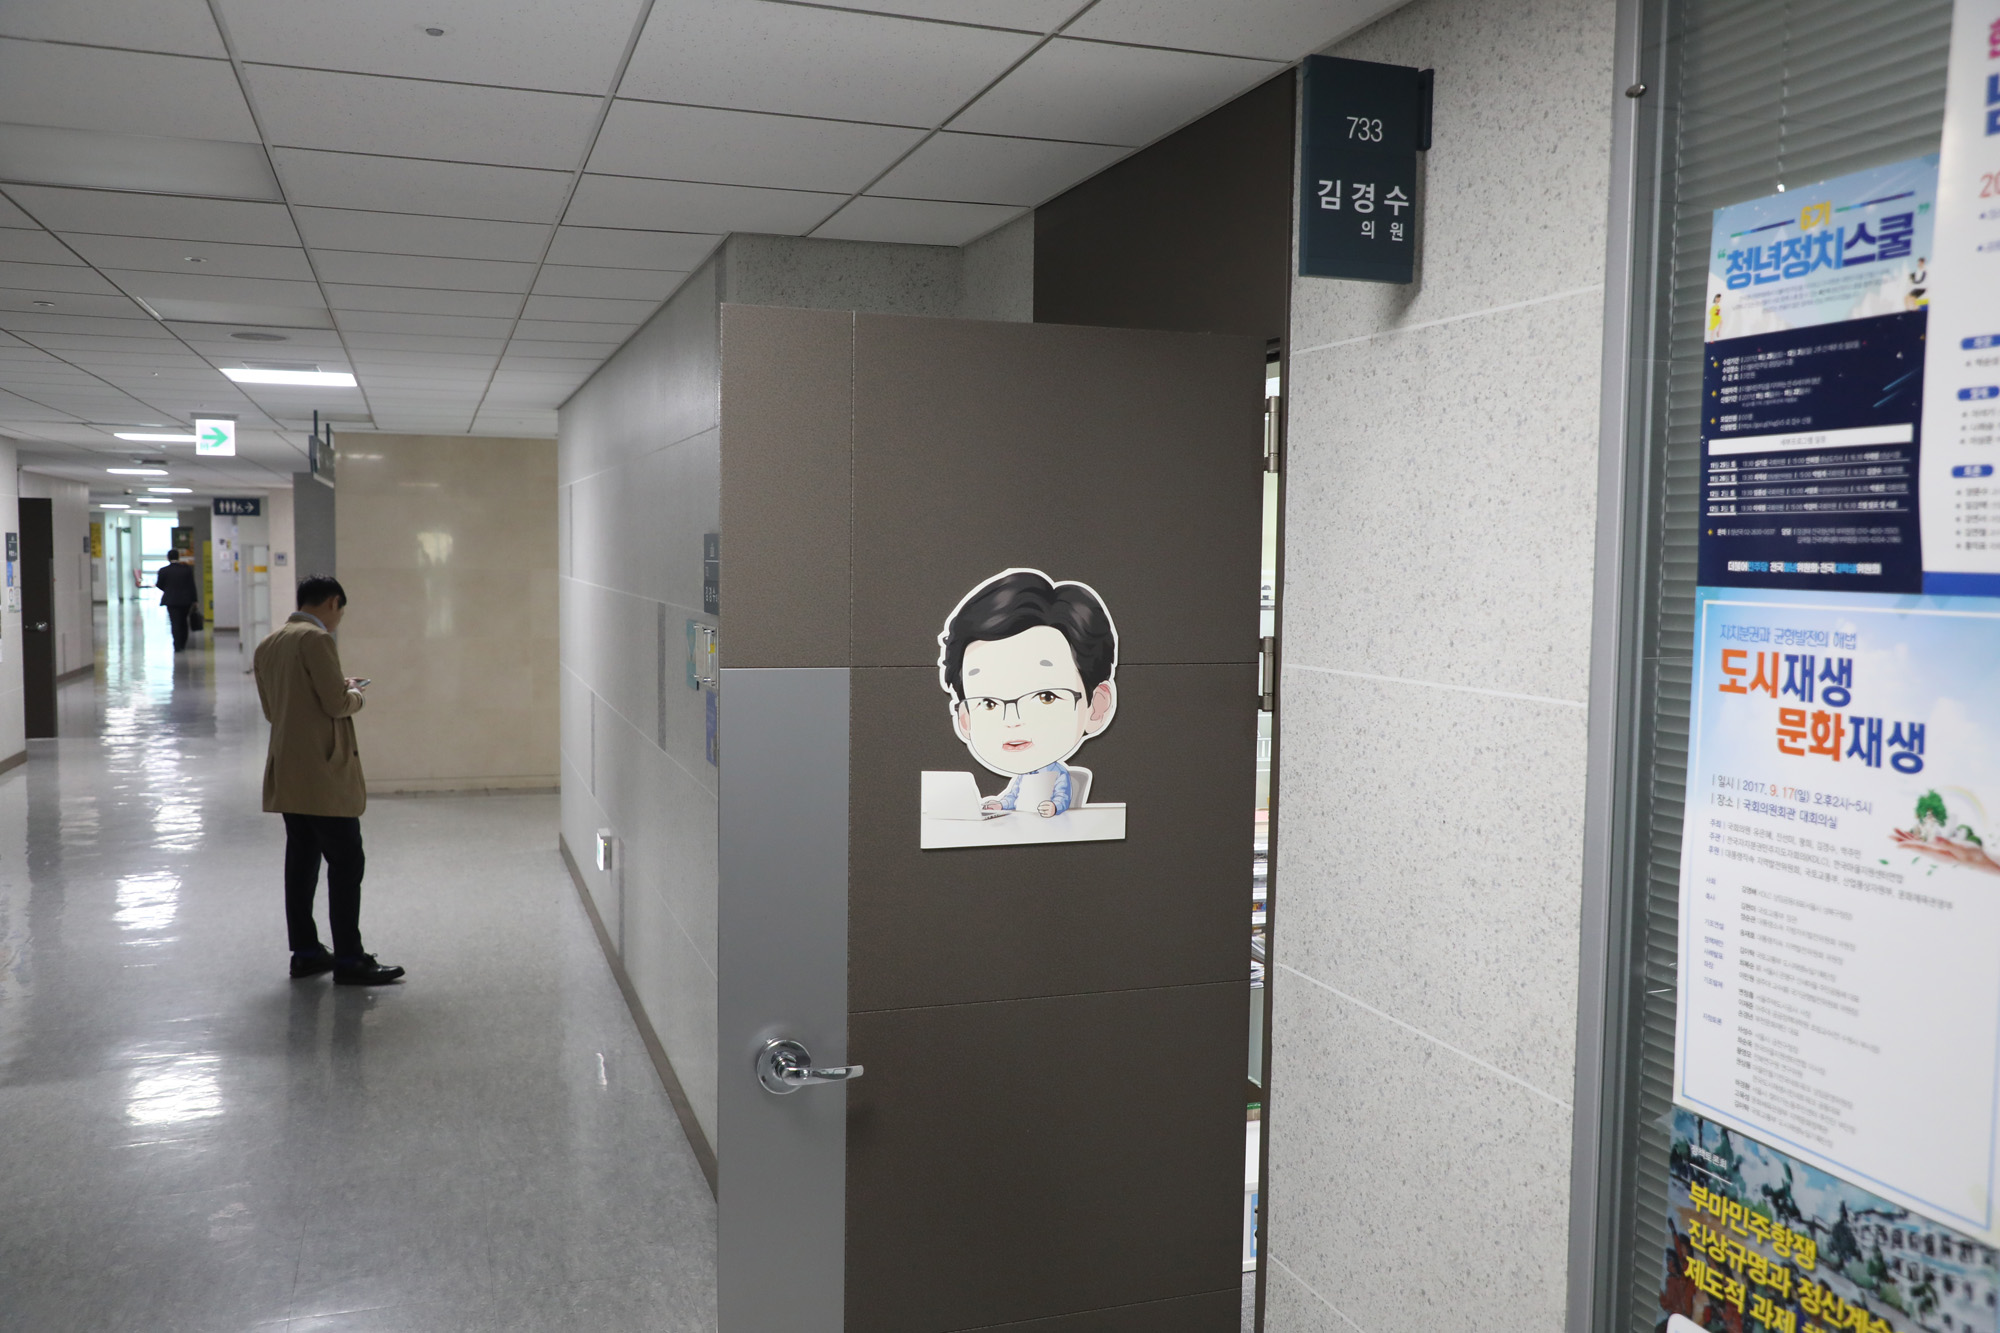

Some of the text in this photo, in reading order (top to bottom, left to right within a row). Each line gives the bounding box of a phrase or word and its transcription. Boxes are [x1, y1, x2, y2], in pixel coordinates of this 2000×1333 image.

[1346, 116, 1383, 142] 733
[1800, 201, 1831, 231] 6기
[1720, 623, 1857, 651] 자치분권과 균형발전의 해법
[1718, 648, 1853, 708] 도시재생
[1776, 707, 1925, 774] 문화재생
[1717, 775, 1735, 789] 일시
[1716, 792, 1838, 830] 장소 국회의원회관 대회의실
[1688, 1180, 1816, 1270] 부마민주항쟁
[1687, 1218, 1792, 1298] 진상규명과
[1684, 1255, 1797, 1333] 제도적 과제
